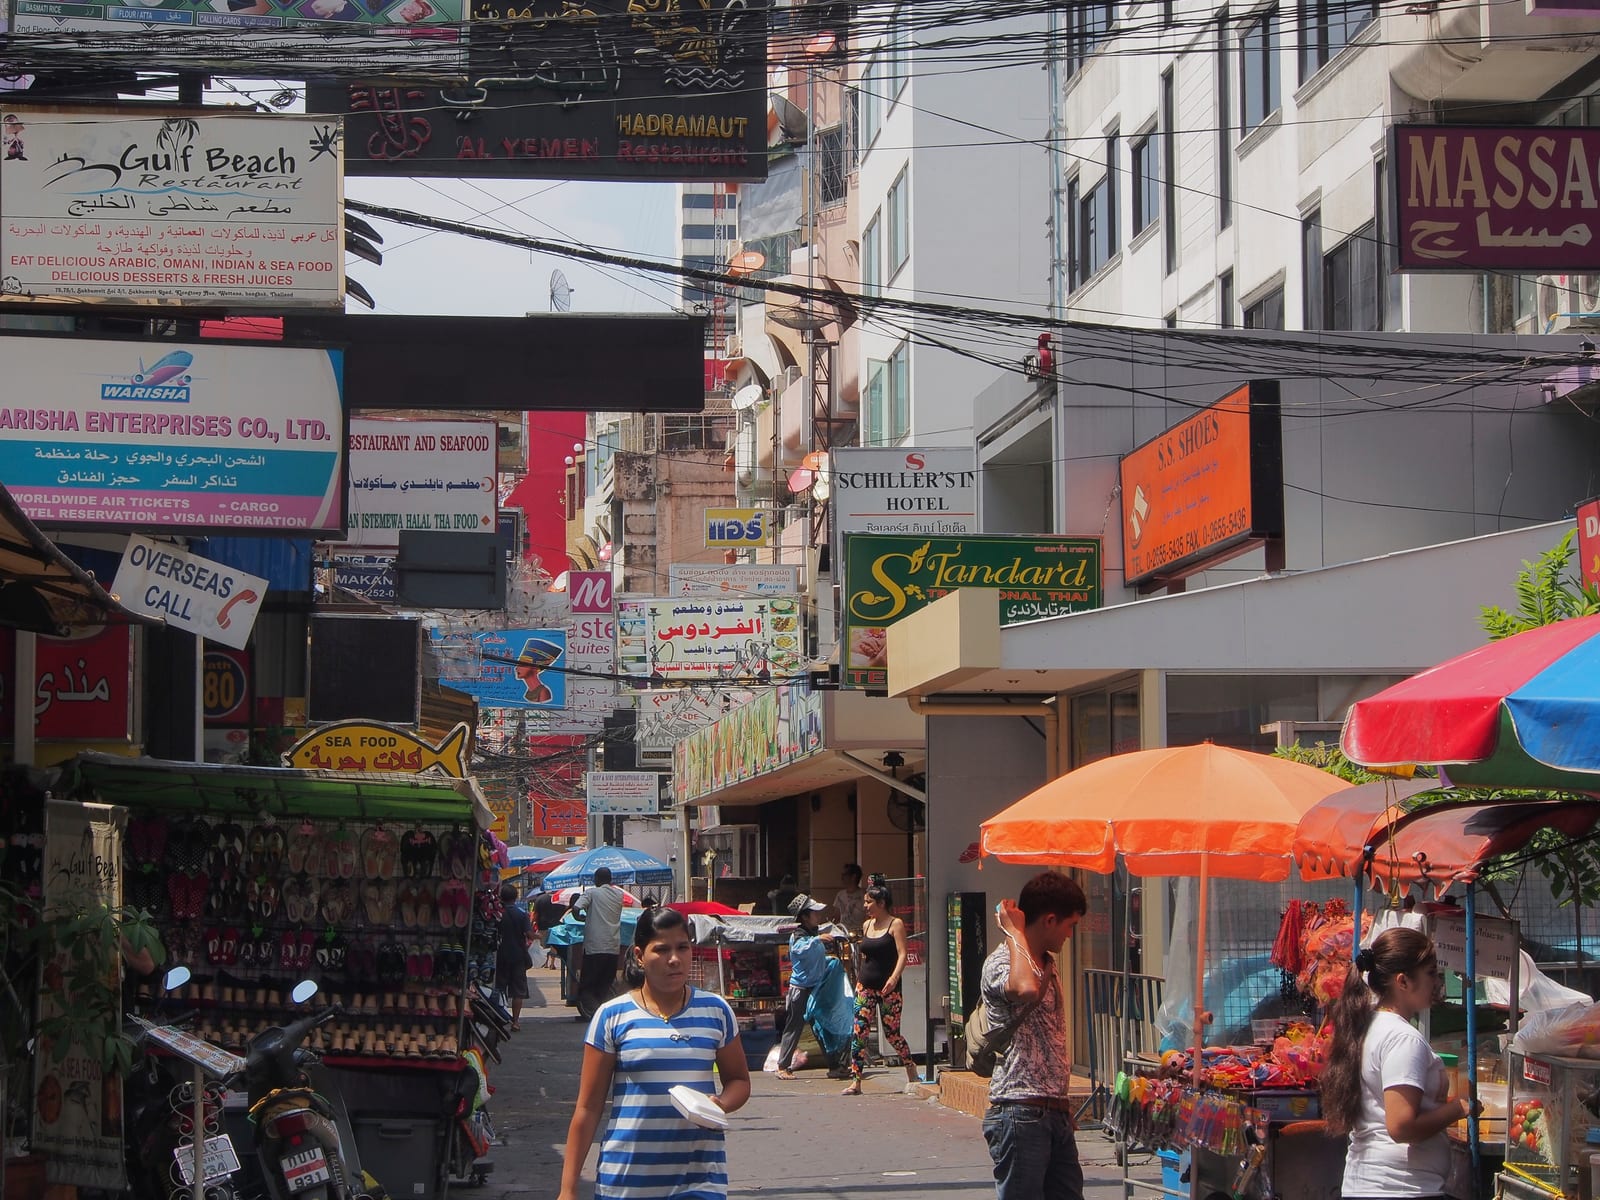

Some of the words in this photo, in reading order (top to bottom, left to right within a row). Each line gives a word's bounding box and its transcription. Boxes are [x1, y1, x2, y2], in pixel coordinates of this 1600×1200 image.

[25, 3, 49, 13] BASMATI
[50, 5, 62, 14] RICE
[199, 15, 221, 24] CALLING
[222, 17, 241, 25] CARDS
[617, 113, 748, 138] HADRAMAUT
[457, 136, 493, 161] AL
[503, 137, 599, 161] YEMEN
[617, 140, 748, 164] Restaurant
[120, 144, 191, 173] Gulf
[206, 147, 296, 174] Beach
[1408, 136, 1600, 209] MASSA
[138, 173, 303, 190] Restaurant
[68, 195, 136, 217] الخليج
[227, 199, 292, 219] مطعم
[290, 233, 317, 244] عربي
[1409, 211, 1592, 258] مساج
[11, 255, 34, 266] EAT
[37, 256, 106, 267] DELICIOUS
[163, 258, 208, 271] OMANI,
[212, 260, 255, 270] INDIAN
[258, 261, 267, 271] &
[270, 261, 295, 271] SEA
[298, 261, 333, 272] FOOD
[52, 271, 120, 282] DELICIOUS
[123, 272, 188, 284] DESSERTS
[192, 274, 200, 284] &
[204, 274, 245, 285] FRESH
[248, 275, 293, 286] JUICES
[103, 386, 188, 401] WARISHA
[85, 412, 232, 437] ENTERPRISES
[237, 417, 279, 443] CO.,
[286, 419, 331, 441] LTD.
[414, 436, 436, 451] AND
[440, 436, 489, 451] SEAFOOD
[1179, 411, 1219, 461] SHOES
[35, 446, 81, 460] منظمة
[126, 452, 173, 467] والجوي
[175, 453, 222, 468] البحري
[224, 454, 266, 467] الشحن
[57, 470, 105, 484] الفنادق
[110, 473, 140, 486] حجز
[161, 474, 197, 487] السفر
[201, 474, 237, 489] تذاكر
[101, 495, 126, 506] AIR
[130, 497, 190, 508] TICKETS
[230, 501, 279, 512] CARGO
[887, 498, 949, 511] HOTEL
[59, 509, 157, 522] RESERVATION
[174, 513, 205, 524] VISA
[210, 514, 307, 527] INFORMATION
[362, 513, 403, 529] ISTEMEWA
[406, 514, 431, 529] HALAL
[434, 514, 451, 529] THA
[454, 514, 478, 529] IFOOD
[708, 512, 765, 541] แอร์
[1585, 516, 1600, 538] D
[130, 544, 234, 599] OVERSEAS
[335, 574, 393, 585] MAKAN
[145, 585, 191, 621] CALL
[1051, 591, 1088, 601] THAI
[672, 603, 712, 616] ومطعم
[715, 602, 744, 615] فندق
[657, 617, 762, 641] الفردوس
[568, 642, 610, 654] Suites
[325, 736, 352, 748] SEA
[360, 736, 397, 748] FOOD
[310, 745, 366, 771] بحرية
[373, 747, 423, 769] أكلات
[70, 852, 94, 877] Gulf
[295, 1172, 321, 1187] 931
